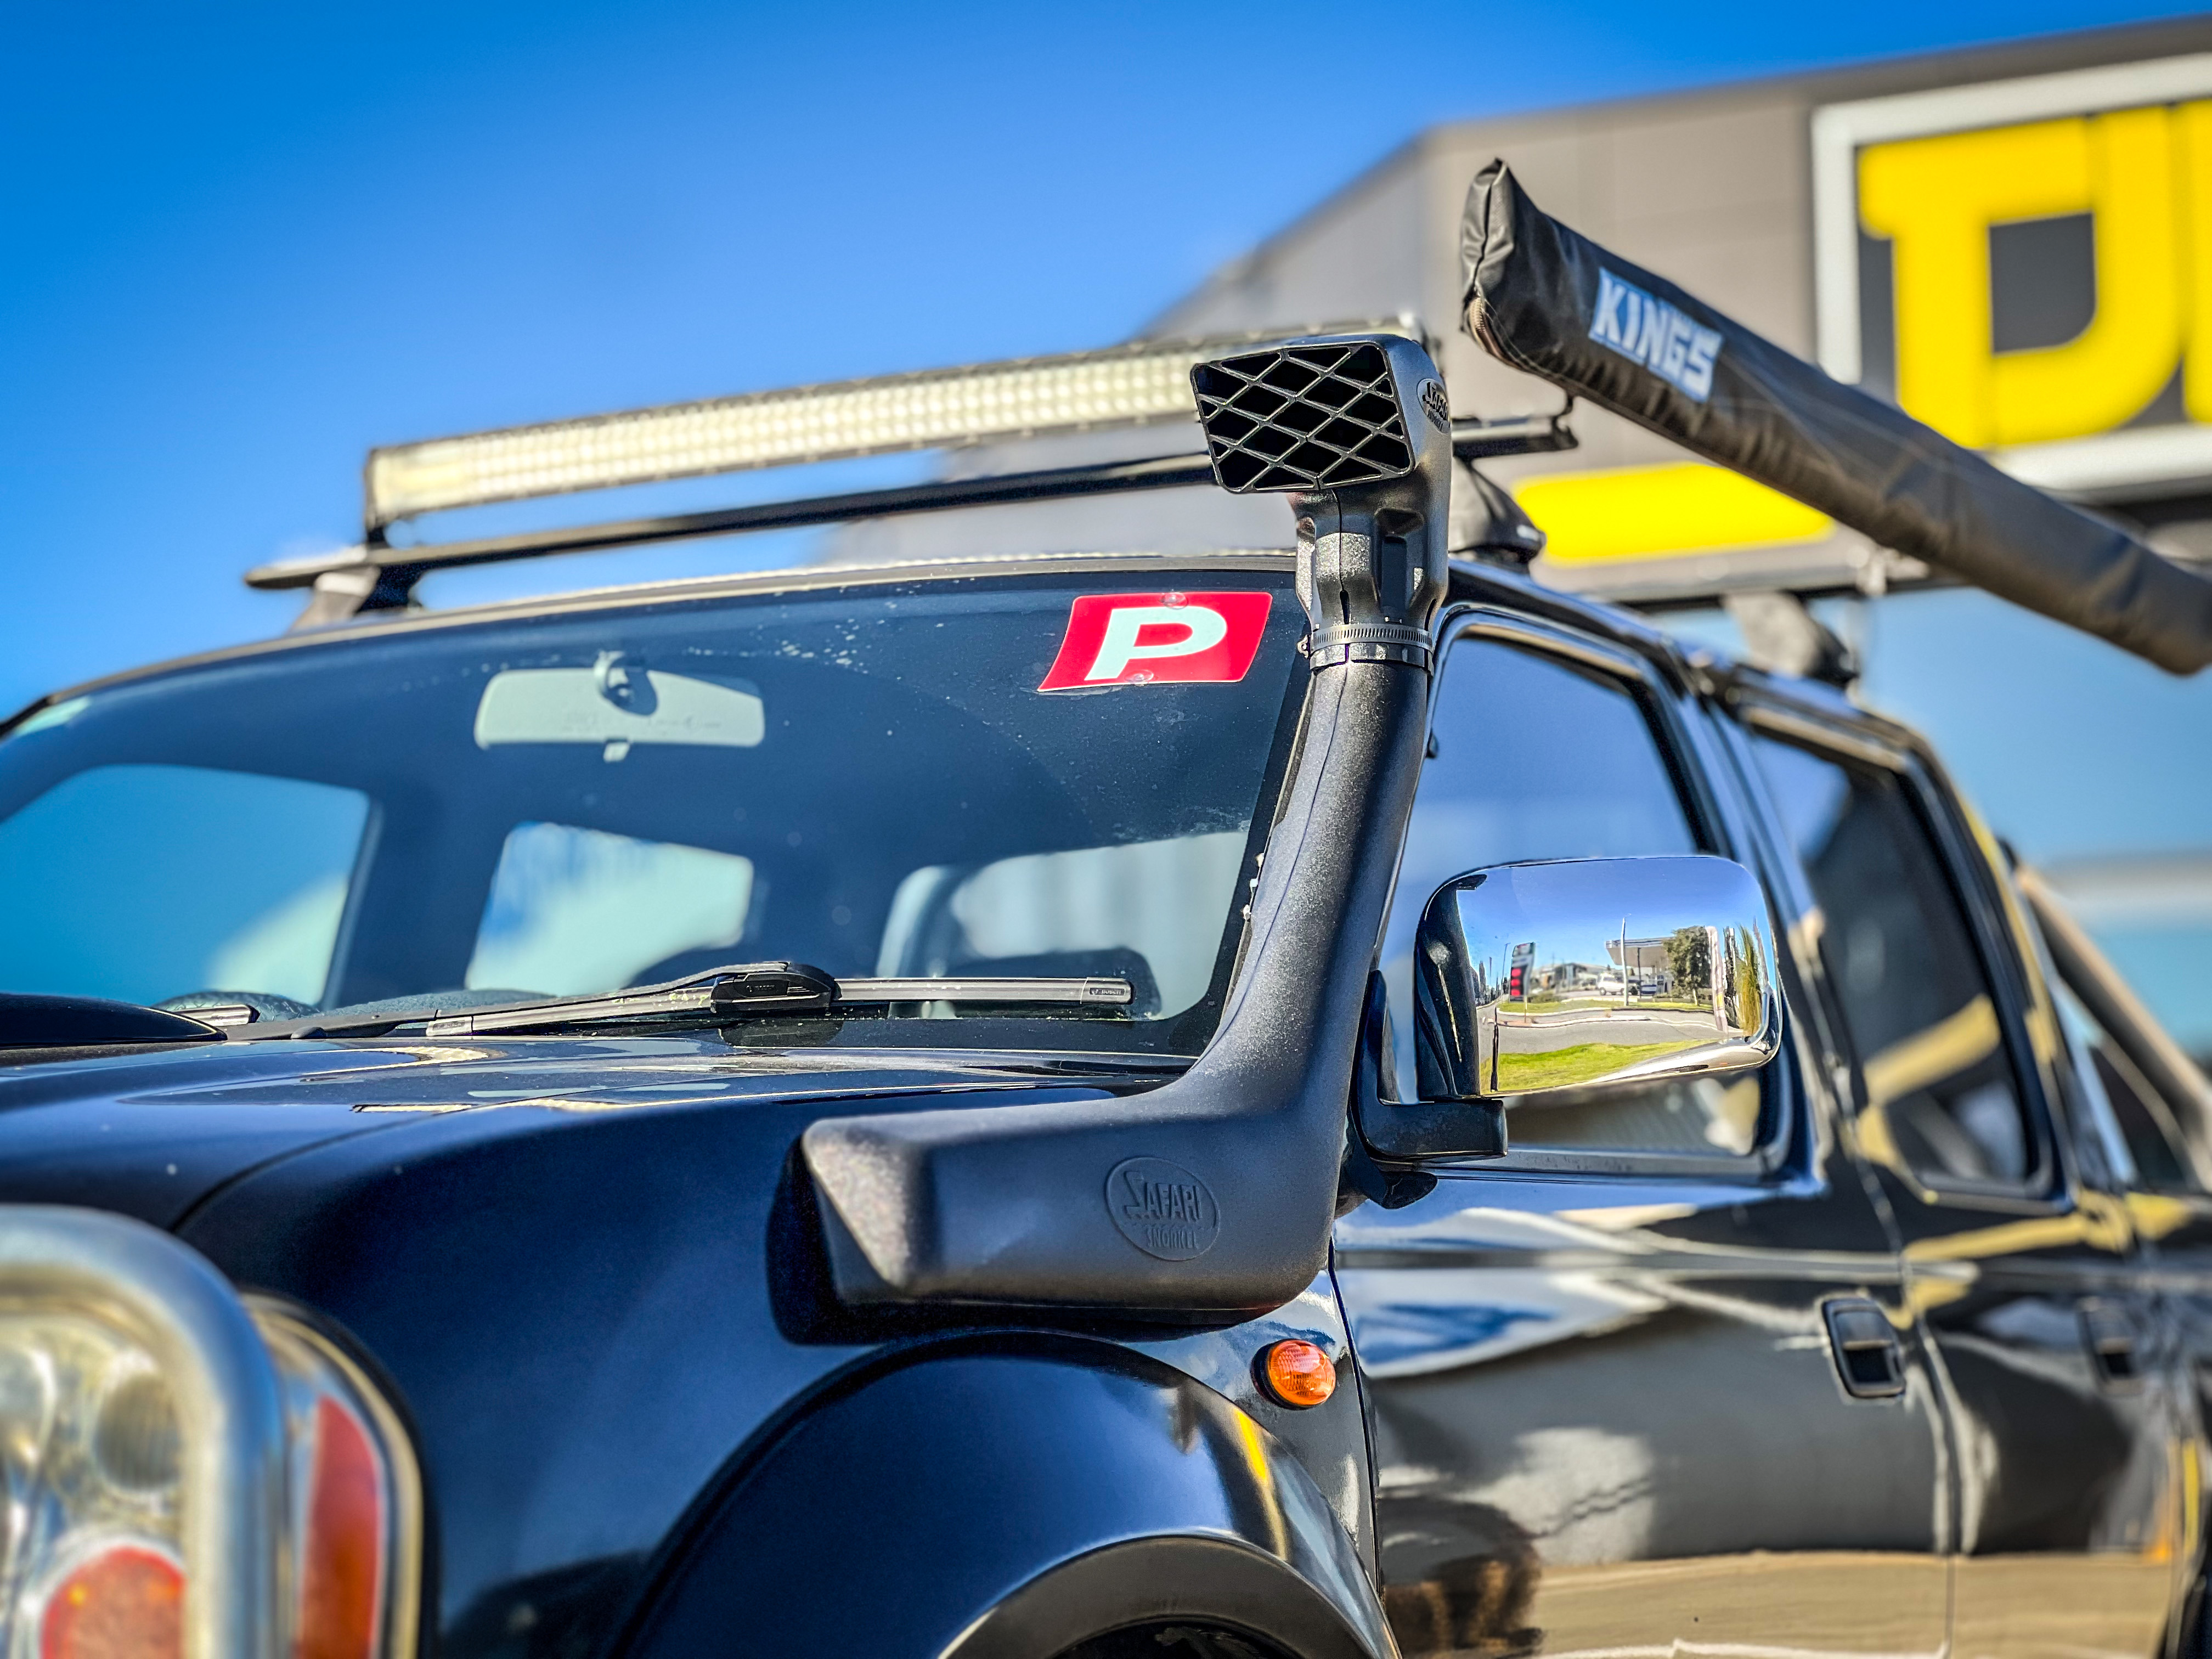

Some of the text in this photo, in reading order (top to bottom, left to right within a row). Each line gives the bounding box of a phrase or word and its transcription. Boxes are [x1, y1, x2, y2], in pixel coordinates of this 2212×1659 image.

[1858, 99, 2212, 451] D
[1590, 270, 1722, 402] KINGS
[1084, 606, 1227, 681] P
[1124, 1171, 1203, 1221] SAFARI
